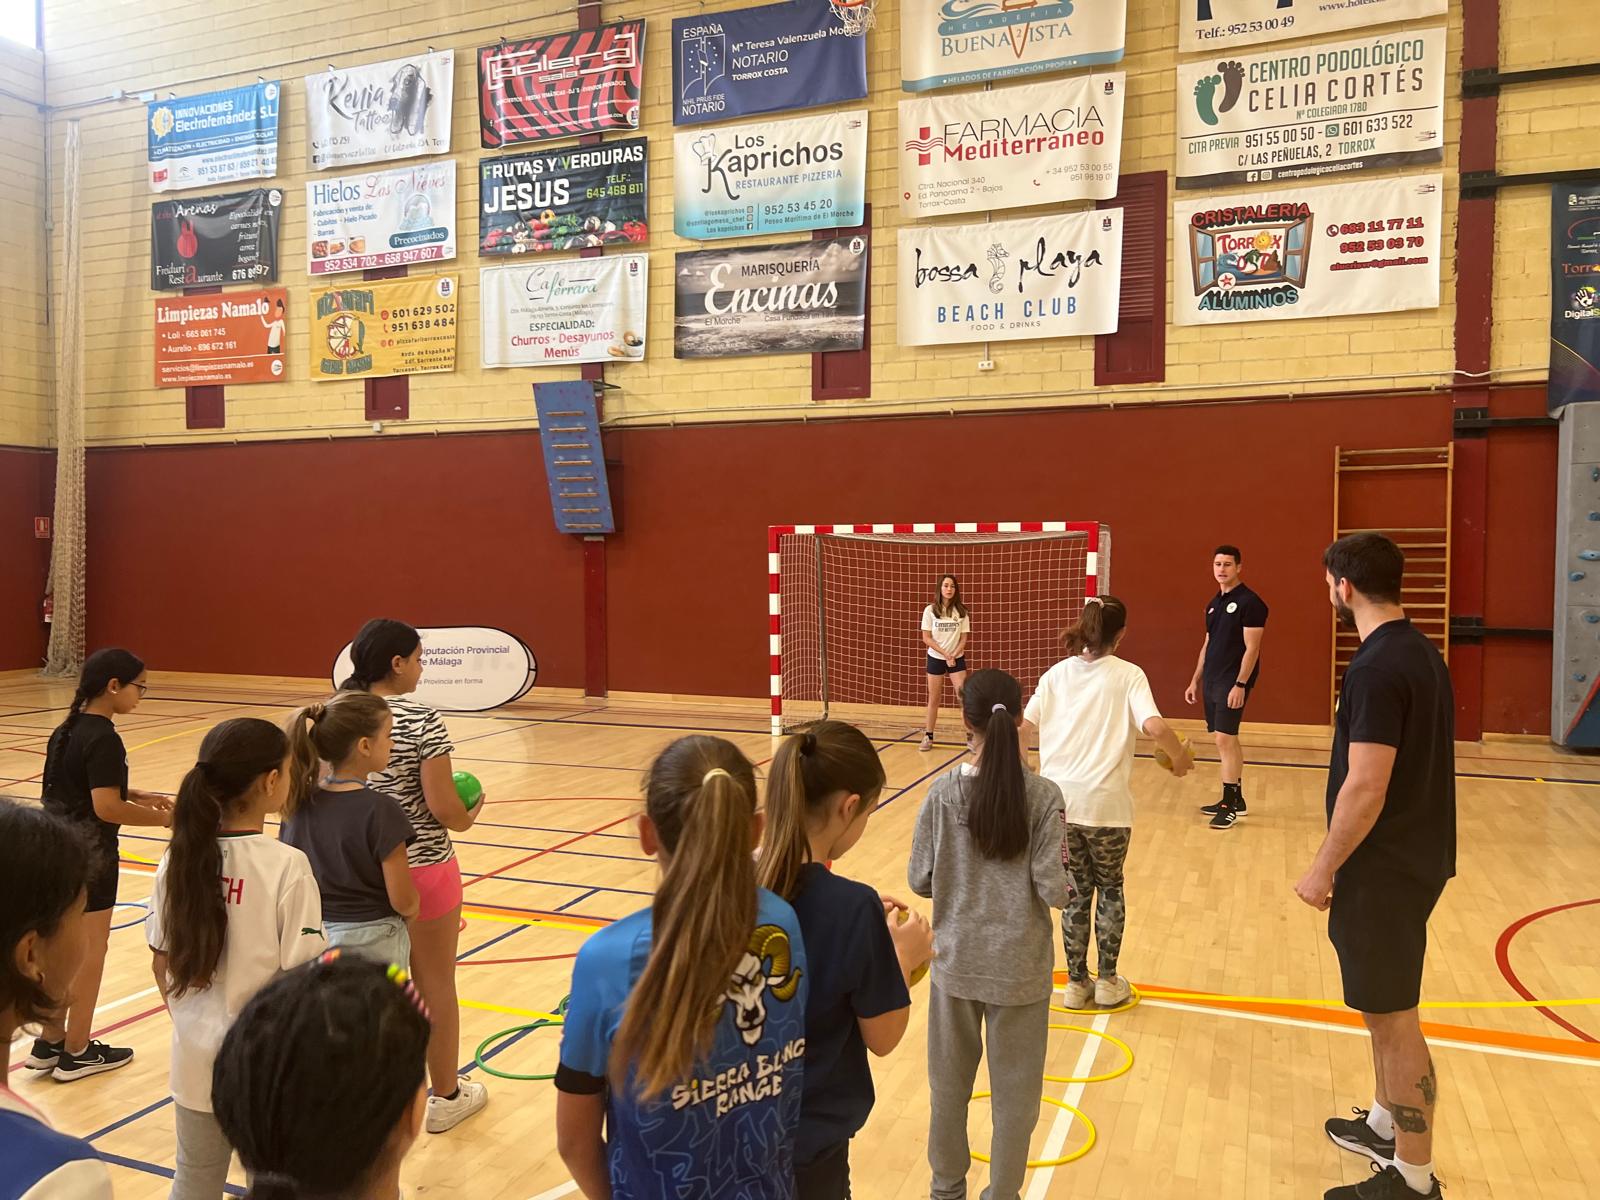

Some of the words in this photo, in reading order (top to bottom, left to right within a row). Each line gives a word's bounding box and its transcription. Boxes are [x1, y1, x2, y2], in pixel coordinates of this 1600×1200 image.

[683, 23, 724, 38] ESPAÑA
[1195, 28, 1226, 41] Telf.:
[1227, 22, 1246, 36] 952
[1249, 20, 1264, 34] 53
[1264, 18, 1279, 32] 00
[1280, 15, 1296, 29] 49
[732, 42, 744, 54] Mª
[746, 38, 776, 51] Teresa
[777, 30, 827, 46] Valenzuela
[732, 50, 790, 70] NOTARIO
[1249, 55, 1311, 84] CENTRO
[1316, 39, 1424, 75] PODOLÓGICO
[537, 70, 578, 83] sala
[732, 70, 762, 81] TORROX
[764, 67, 789, 77] COSTA
[948, 73, 982, 84] HELADOS
[983, 71, 992, 80] DE
[992, 64, 1044, 79] FABRICACIÓN
[1045, 60, 1073, 71] PROPIA
[1248, 81, 1317, 114] CELIA
[1327, 64, 1424, 103] CORTÉS
[175, 99, 234, 119] INNOVACIONES
[682, 100, 726, 116] NOTARIO
[1306, 104, 1348, 120] COLEGIADA
[1350, 100, 1368, 113] 1780
[944, 105, 1104, 145] FARMACIA
[735, 134, 766, 150] Los
[1188, 141, 1208, 155] CITA
[1210, 136, 1240, 152] PREVIA
[1245, 133, 1265, 149] 951
[1266, 130, 1280, 146] 55
[1283, 129, 1298, 144] 00
[1300, 126, 1315, 142] 50
[1343, 120, 1363, 137] 601
[1366, 116, 1388, 132] 633
[1392, 114, 1413, 130] 522
[944, 130, 1104, 163] Mediterráneo
[1238, 153, 1248, 167] C/
[1251, 150, 1268, 166] LAS
[1271, 144, 1323, 163] PEÑUELAS,
[1325, 143, 1332, 157] 2
[1338, 137, 1376, 156] TORROX
[482, 160, 544, 180] FRUTAS
[546, 157, 559, 172] Y
[561, 145, 644, 171] VERDURAS
[701, 142, 844, 201] Kaprichos
[1064, 164, 1078, 173] 952
[1092, 164, 1102, 172] 00
[736, 175, 800, 190] RESTAURANTE
[802, 170, 842, 184] PIZZERIA
[936, 177, 970, 189] Nacional
[970, 176, 986, 186] 340
[314, 180, 361, 205] Hielos
[586, 187, 606, 200] 645
[607, 184, 626, 197] 469
[628, 182, 644, 194] 811
[929, 188, 969, 201] Panorama
[982, 184, 1003, 196] Bajos
[175, 204, 218, 218] Arenas
[764, 204, 784, 216] 952
[786, 203, 800, 213] 53
[803, 201, 817, 212] 45
[820, 198, 832, 210] 20
[1190, 202, 1312, 230] CRISTALERIA
[764, 216, 782, 226] Paseo
[1368, 220, 1385, 232] 11
[1386, 218, 1404, 230] 77
[1406, 216, 1424, 229] 11
[394, 230, 445, 247] Precocinados
[1340, 241, 1365, 254] 952
[1367, 239, 1384, 252] 53
[1386, 238, 1404, 250] 03
[1406, 236, 1424, 248] 70
[324, 259, 341, 272] 952
[342, 258, 358, 270] 534
[361, 256, 377, 268] 702
[384, 252, 401, 264] 658
[403, 250, 419, 262] 947
[420, 248, 438, 260] 607
[741, 257, 820, 278] MARISQUERÍA
[914, 247, 980, 289] bossa
[1018, 236, 1103, 293] playa
[232, 269, 247, 281] 676
[704, 263, 839, 316] Encinas
[1198, 288, 1299, 312] ALUMINIOS
[157, 305, 219, 325] Limpiezas
[221, 298, 270, 318] Namalo
[392, 309, 410, 319] 601
[412, 305, 433, 316] 629
[435, 303, 456, 314] 502
[938, 302, 1004, 324] BEACH
[1023, 296, 1077, 318] CLUB
[392, 322, 409, 333] 951
[412, 320, 430, 331] 638
[433, 318, 455, 328] 484
[529, 319, 595, 332] ESPECIALIDAD:
[704, 318, 712, 326] El
[714, 316, 742, 326] Morche
[970, 324, 995, 332] FOOD
[1000, 322, 1006, 330] &
[1010, 320, 1042, 330] DRINKS
[511, 334, 550, 347] Churros
[559, 330, 614, 344] Desayunos
[168, 344, 192, 354] Aurelio
[544, 346, 580, 359] Menús
[423, 646, 465, 658] iputación
[466, 645, 510, 656] Provincial
[429, 657, 462, 668] Málaga
[424, 678, 453, 686] Provincia
[716, 1075, 783, 1118] RANGE
